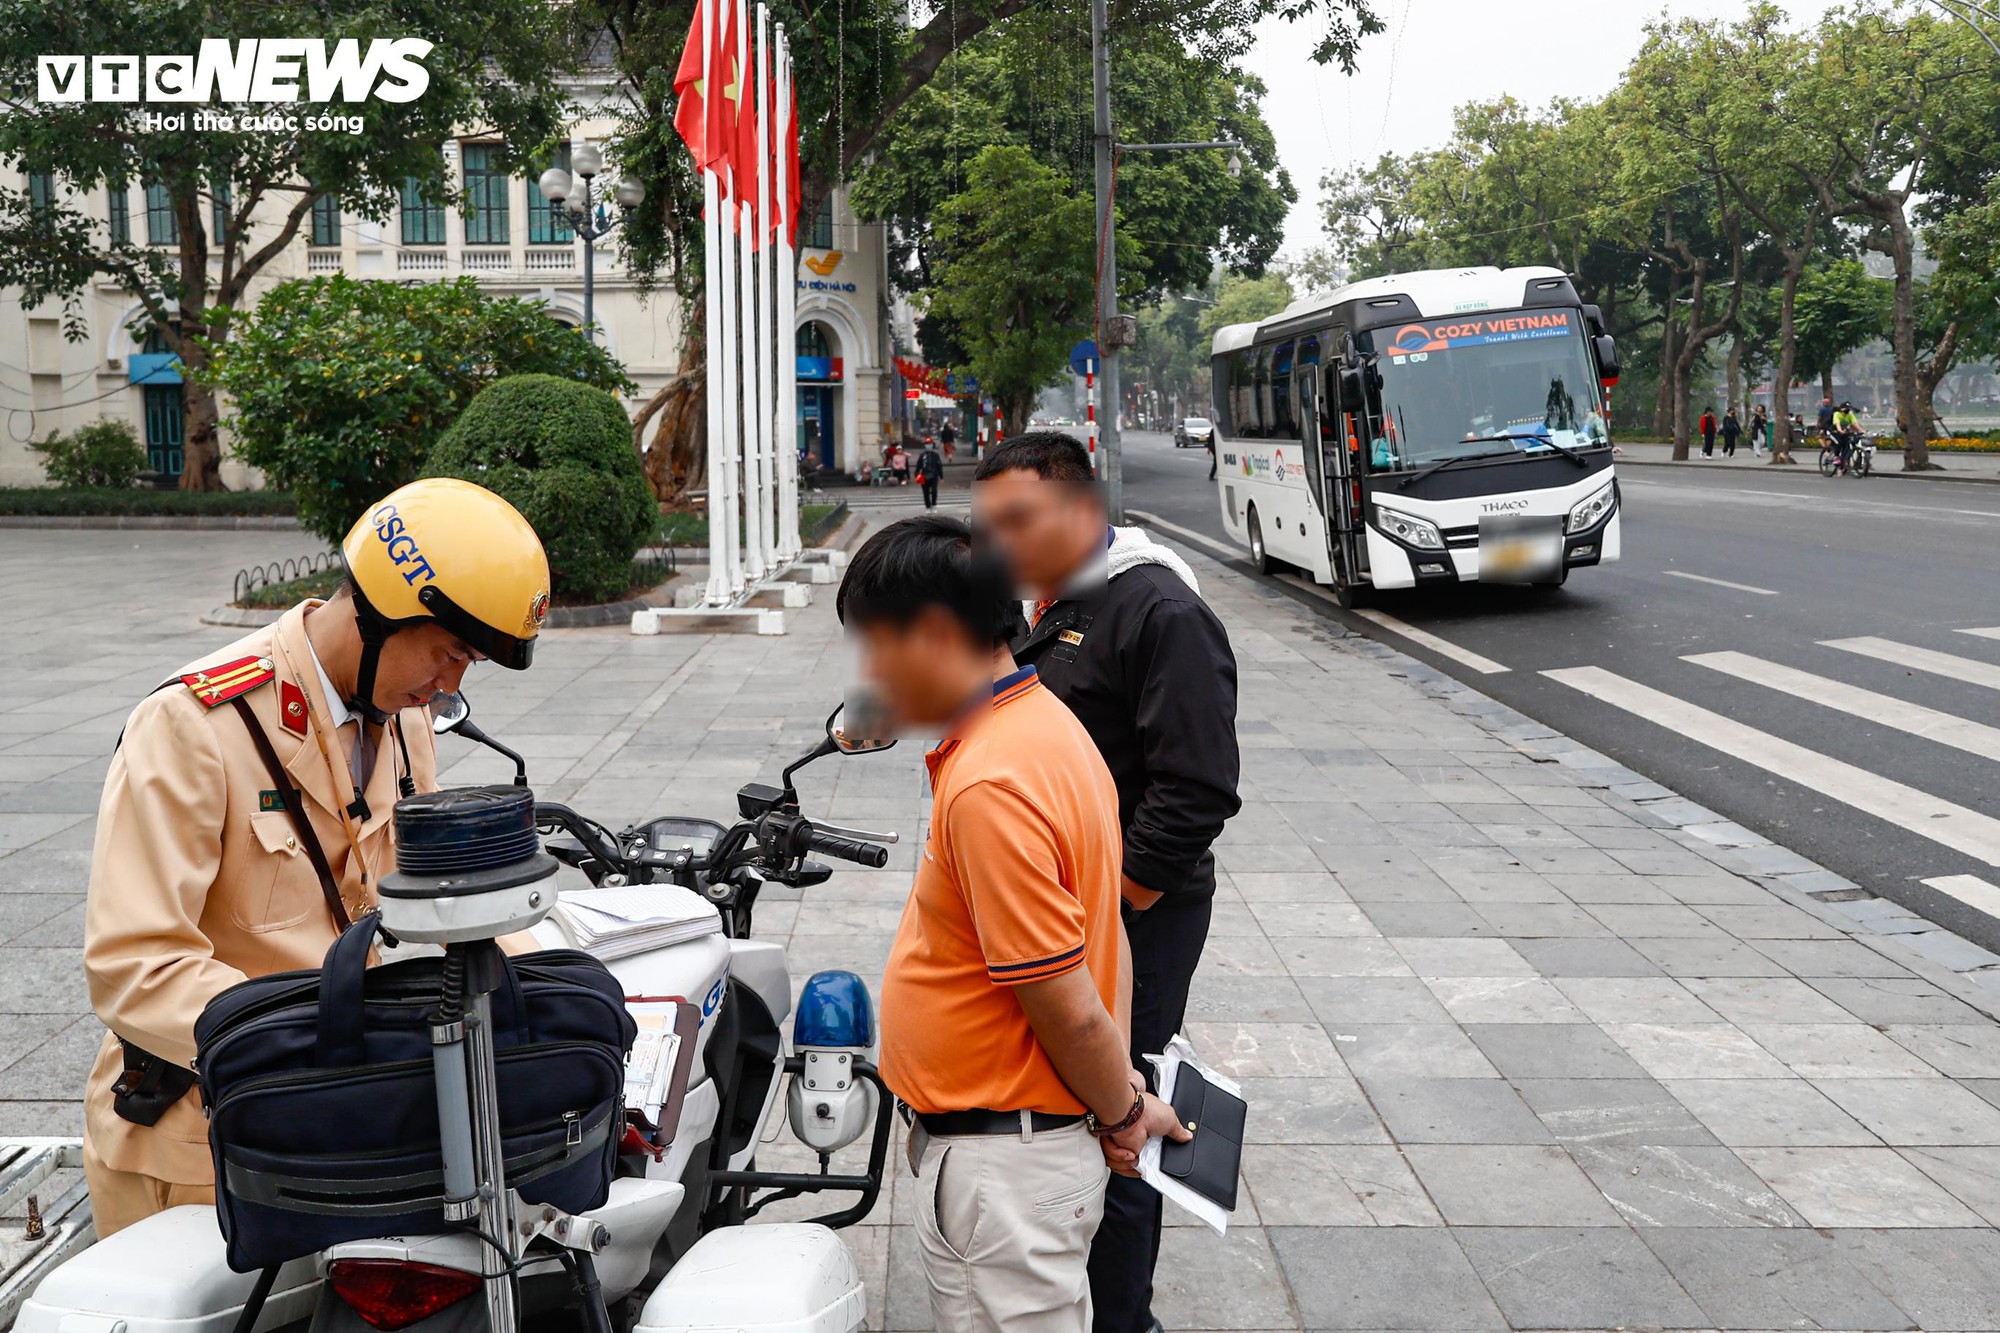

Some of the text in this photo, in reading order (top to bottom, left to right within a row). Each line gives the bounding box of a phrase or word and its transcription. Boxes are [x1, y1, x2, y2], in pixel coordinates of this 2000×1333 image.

[1434, 313, 1568, 340] COZY VIETNAM
[1484, 328, 1568, 344] Travel With Excellence
[1480, 499, 1529, 513] THACO
[372, 504, 436, 587] CSGT
